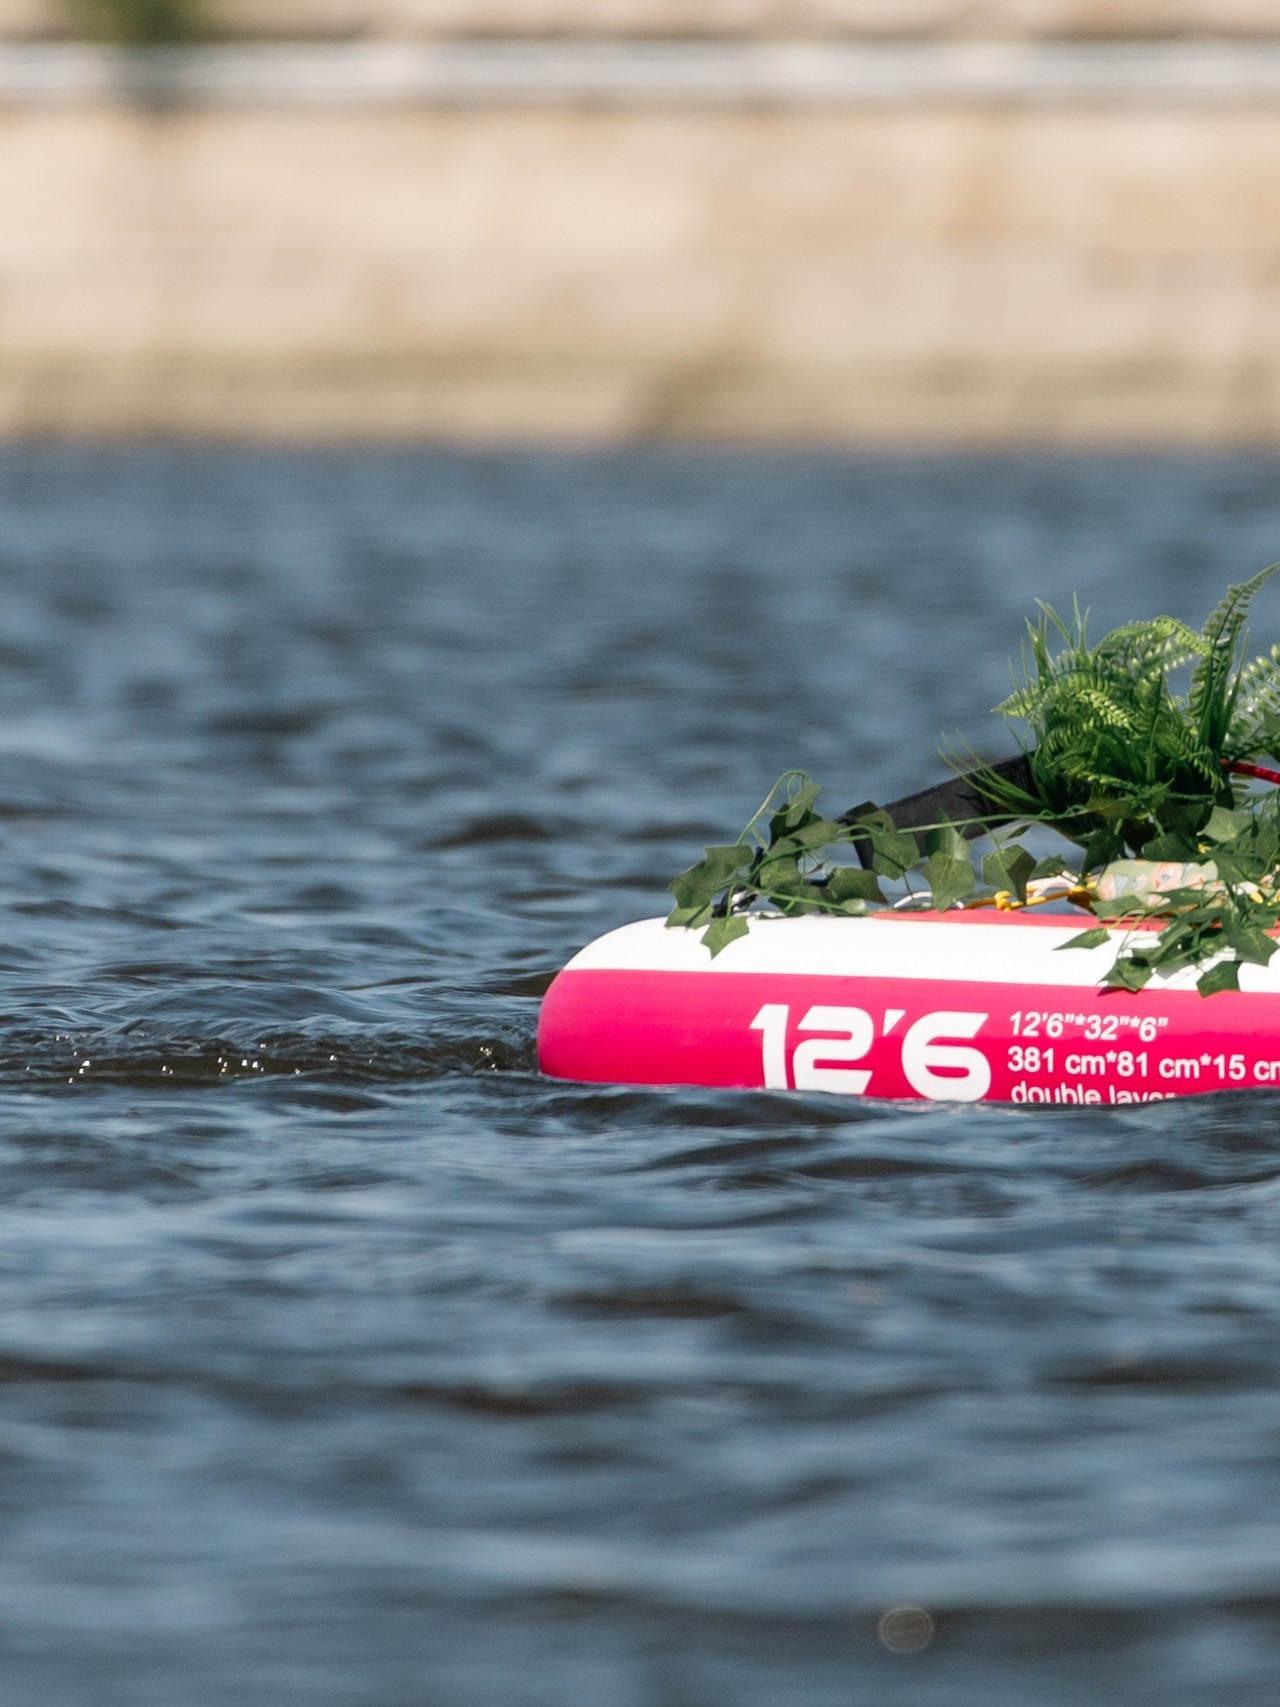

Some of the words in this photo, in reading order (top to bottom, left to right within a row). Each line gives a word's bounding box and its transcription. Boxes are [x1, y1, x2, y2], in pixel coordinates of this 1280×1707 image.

[749, 1003, 992, 1102] 12'6
[1007, 1045, 1054, 1073] 381
[1011, 1081, 1102, 1105] double
[1109, 1085, 1175, 1105] lay
